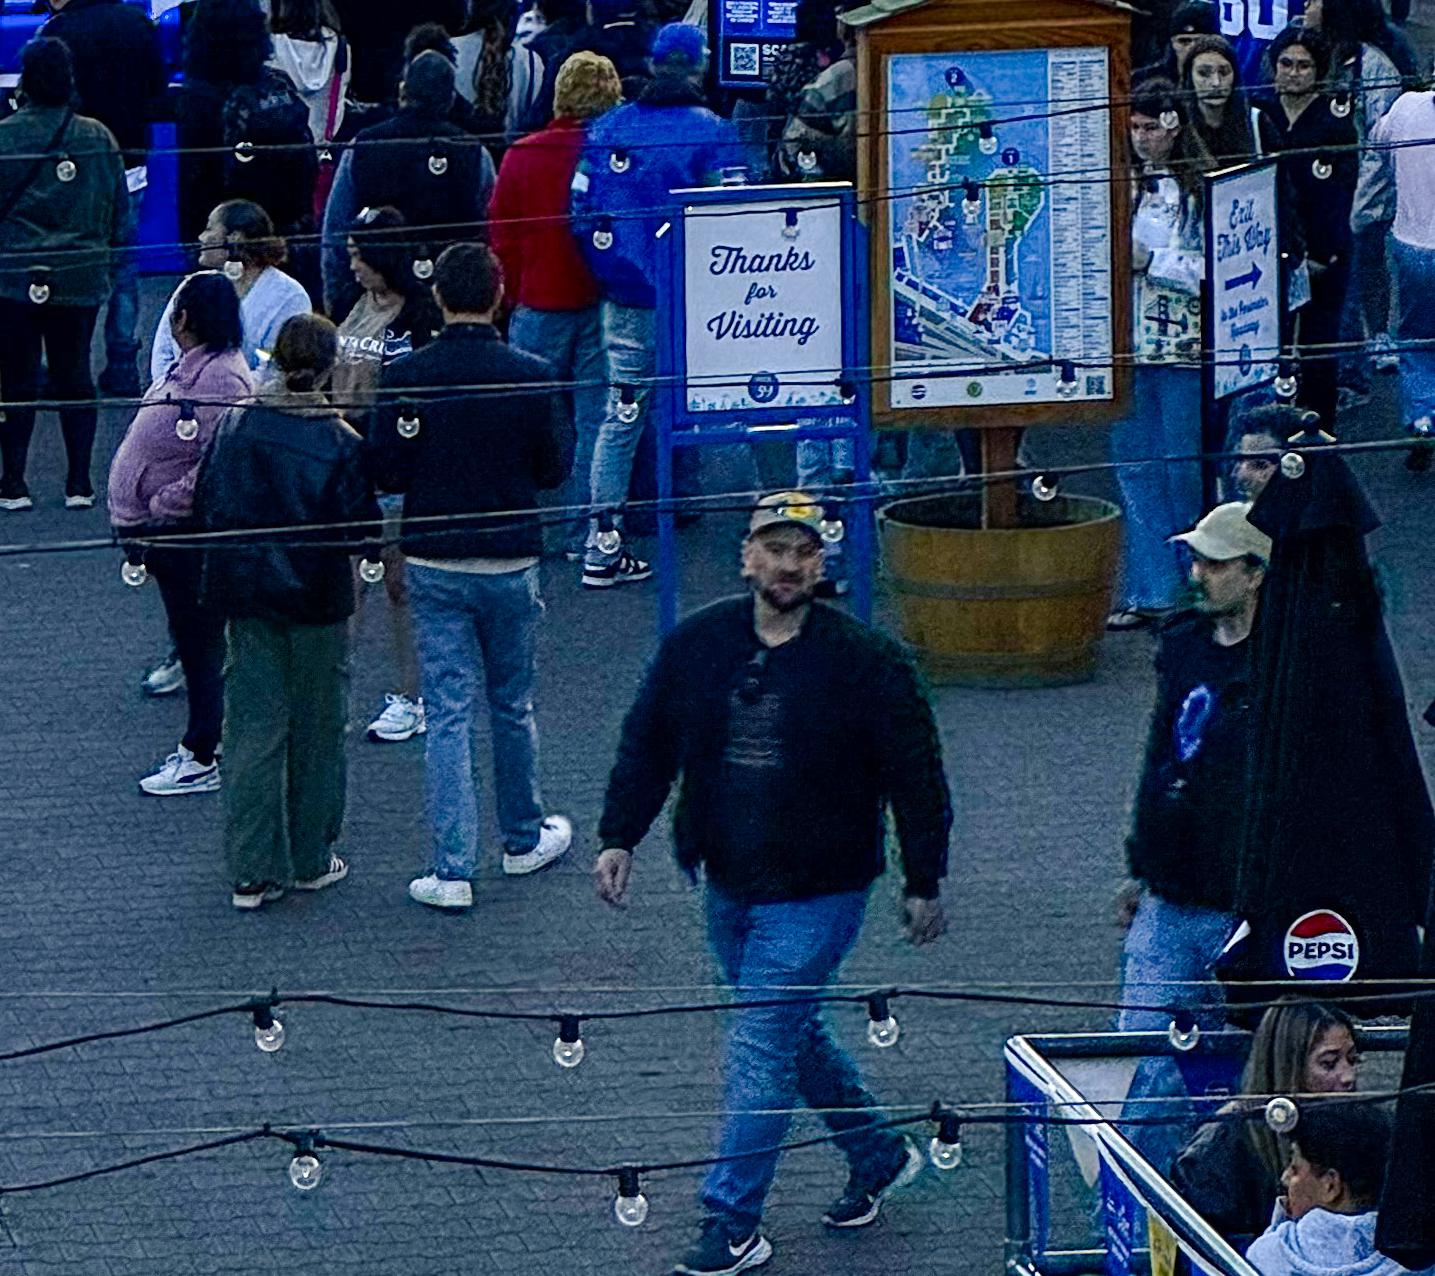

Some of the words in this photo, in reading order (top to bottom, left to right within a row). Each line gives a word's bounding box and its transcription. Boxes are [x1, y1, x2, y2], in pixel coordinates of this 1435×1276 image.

[710, 245, 816, 276] Thanks
[744, 282, 778, 305] for
[706, 310, 820, 346] Visiting
[1288, 941, 1354, 960] PEPSI
